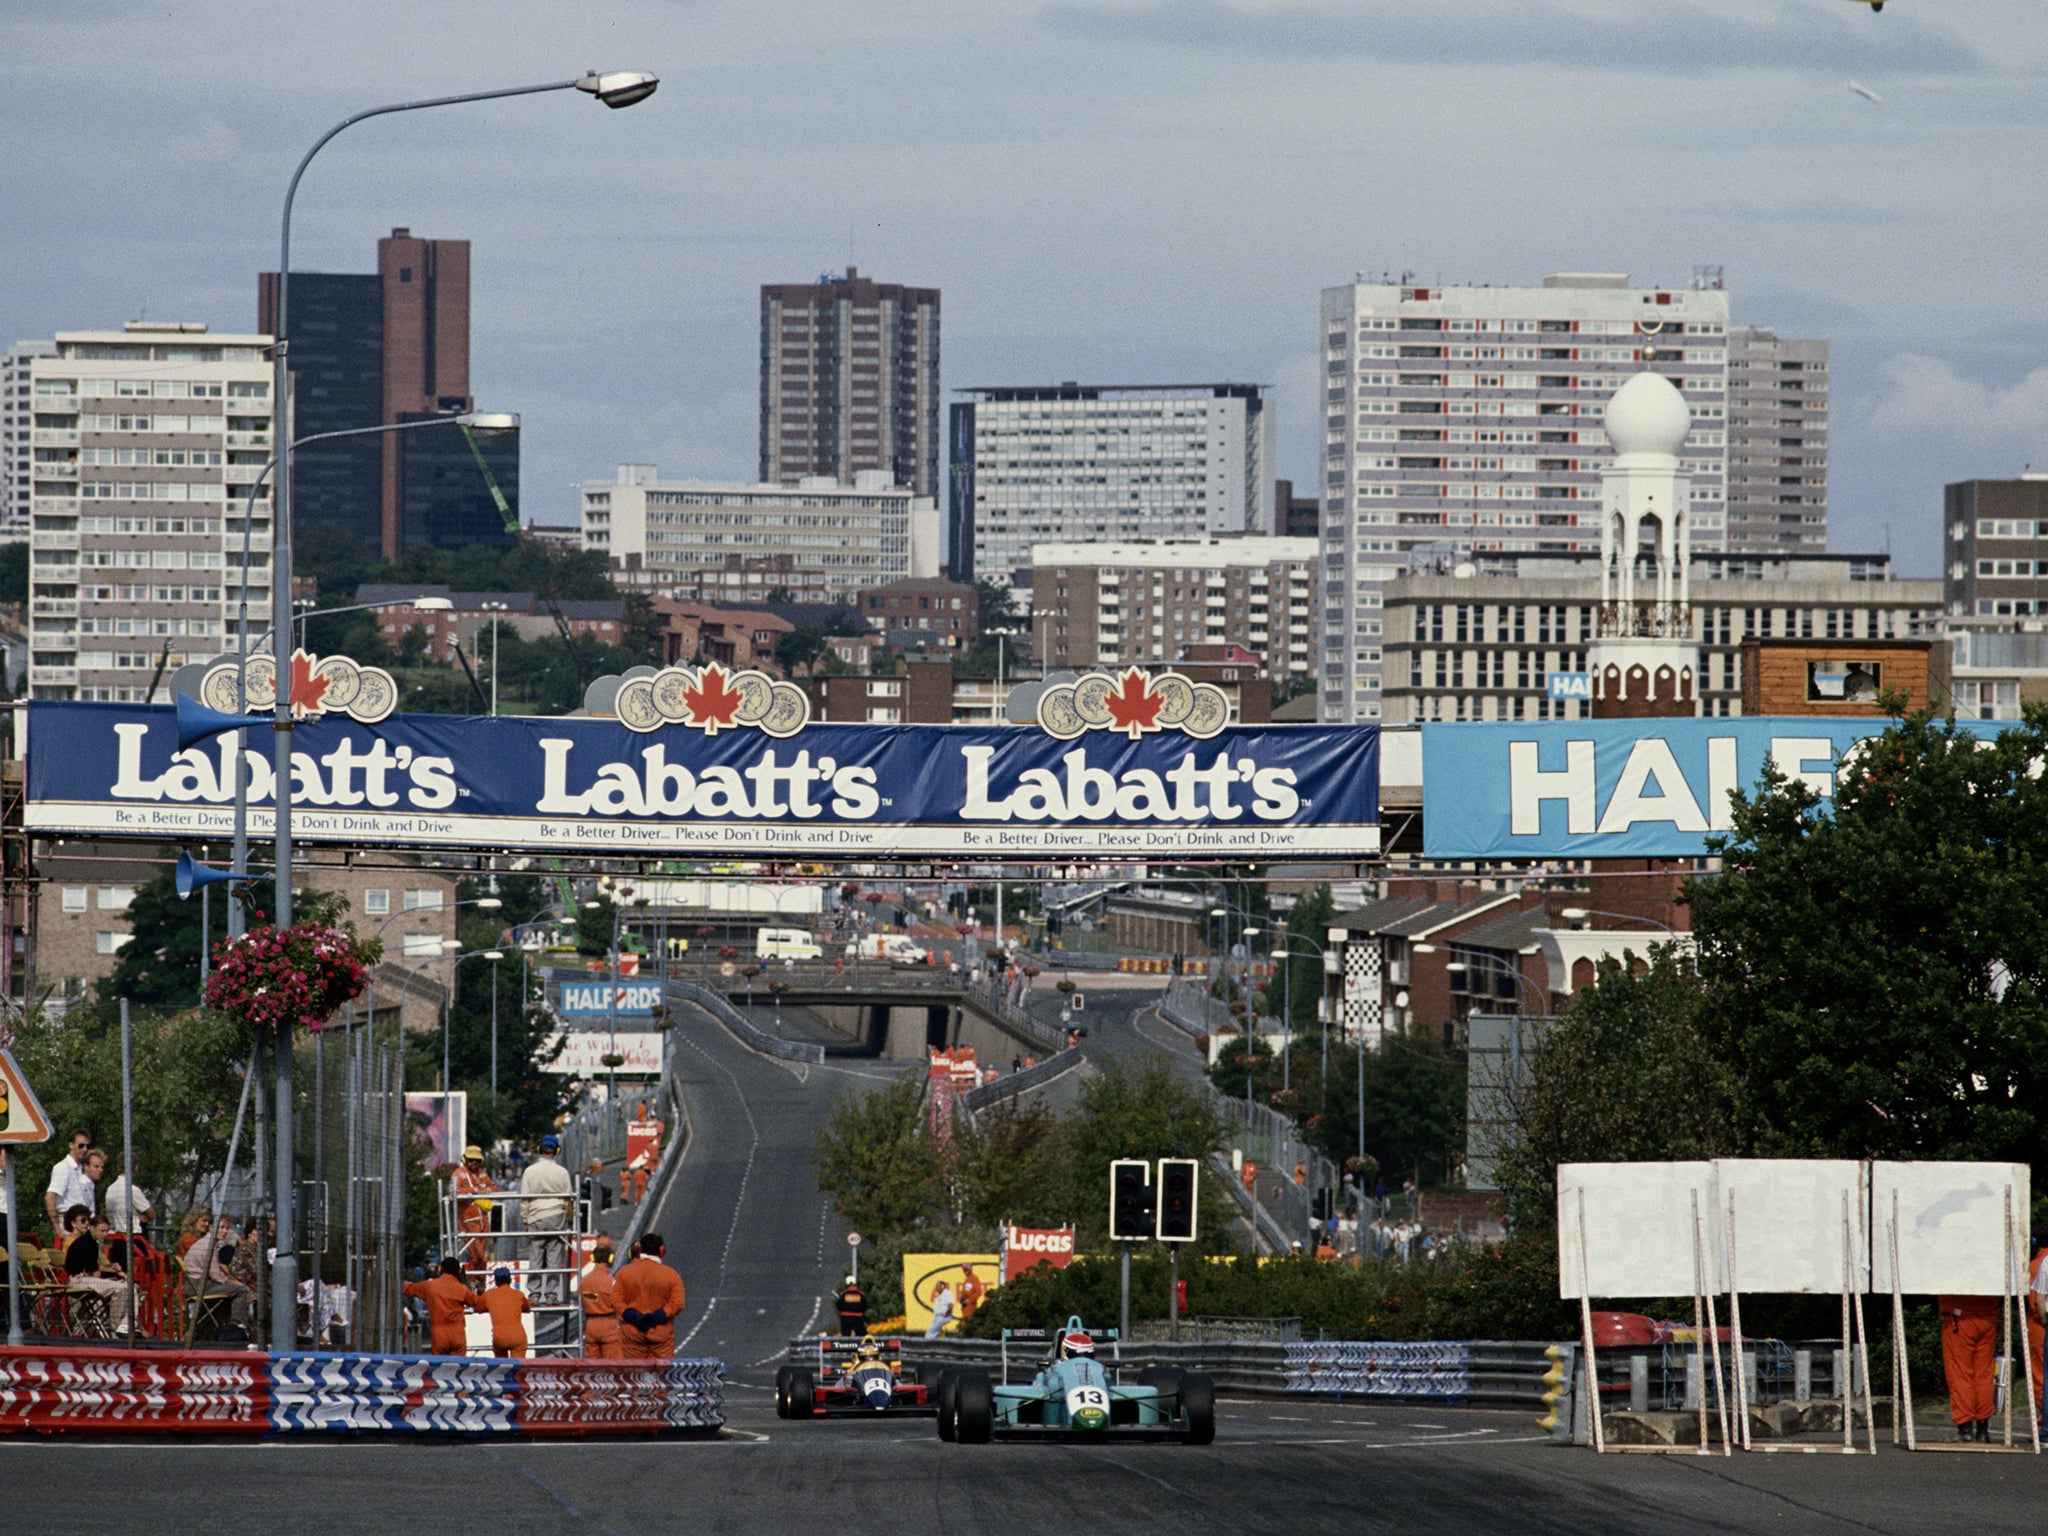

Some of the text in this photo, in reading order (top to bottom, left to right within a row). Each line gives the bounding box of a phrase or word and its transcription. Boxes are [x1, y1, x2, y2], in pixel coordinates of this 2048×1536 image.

[110, 723, 456, 808] Labatt's
[535, 738, 879, 819] Labatt's
[958, 745, 1299, 821] Labatt's
[116, 810, 132, 822] Be
[138, 814, 146, 822] a
[152, 811, 191, 824] Better
[253, 814, 296, 828] Plee
[302, 816, 337, 829] Don't
[343, 817, 380, 831] Drink
[386, 819, 412, 832] and
[418, 820, 452, 833] Drive
[540, 824, 556, 837] Be
[562, 828, 570, 837] a
[577, 825, 616, 838] Better
[675, 827, 718, 840] Please
[724, 828, 760, 841] Don't
[765, 829, 802, 842] Drink
[808, 830, 833, 842] and
[839, 830, 873, 843] Drive
[963, 832, 980, 844] Be
[985, 835, 992, 844] a
[1000, 832, 1038, 844] Better
[1098, 833, 1140, 845] Please
[1146, 832, 1181, 845] Don't
[1187, 832, 1223, 844] Drink
[1229, 832, 1255, 844] and
[1260, 832, 1294, 844] Drive
[565, 988, 661, 1010] HALFORDS
[628, 1124, 658, 1136] Lucas
[1009, 1226, 1072, 1252] Lucas
[868, 1380, 887, 1390] 31
[1075, 1390, 1103, 1405] 13
